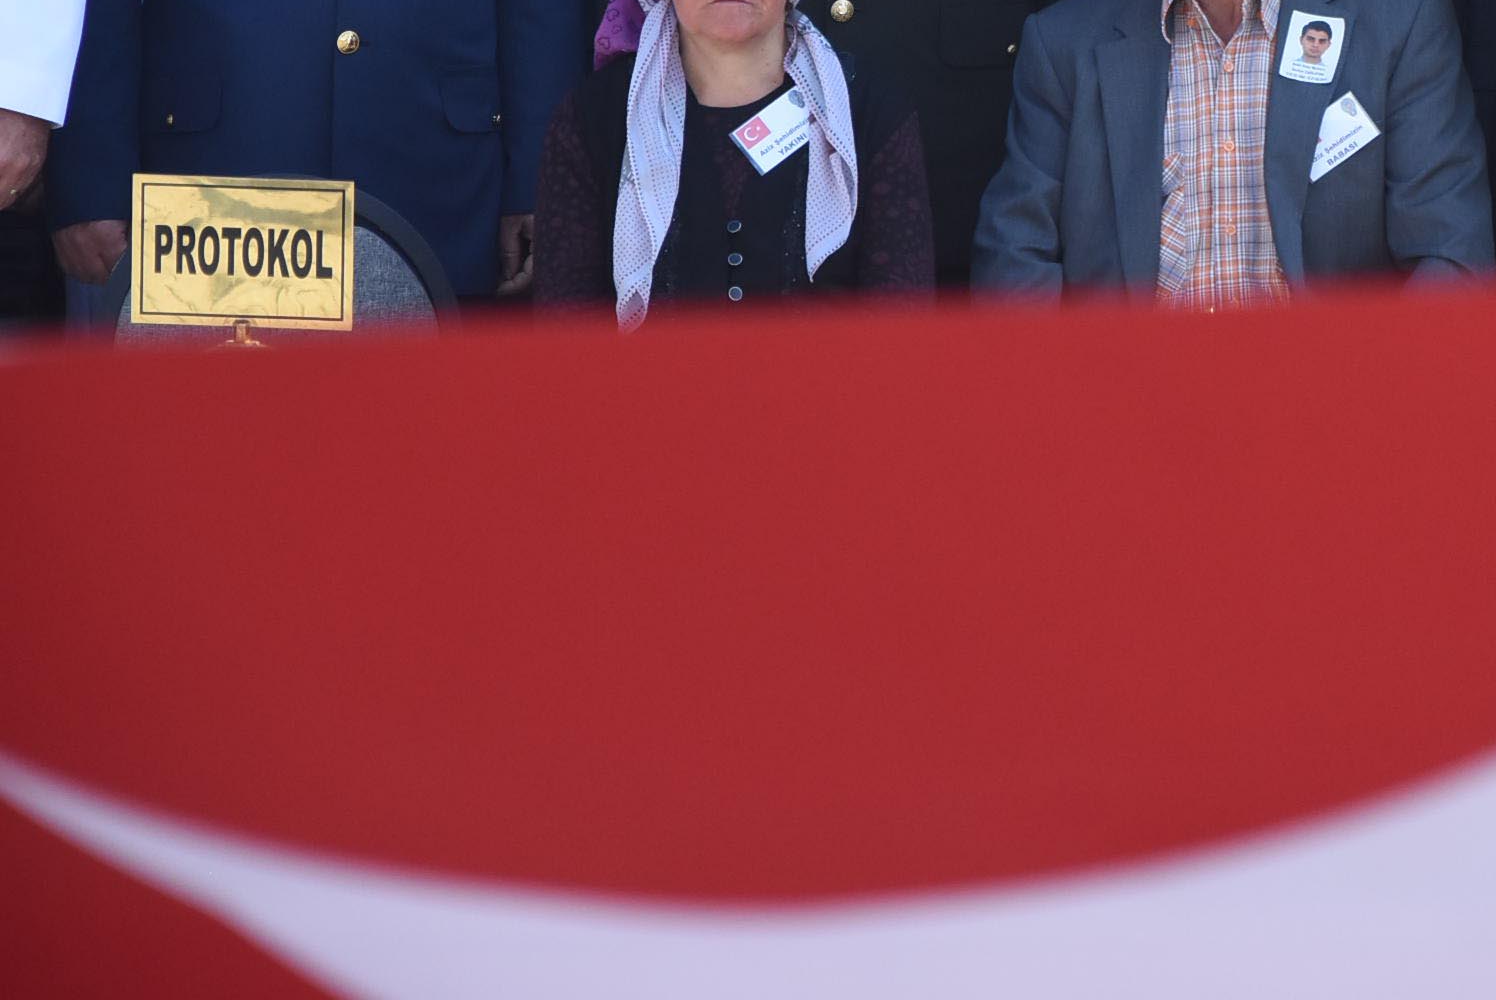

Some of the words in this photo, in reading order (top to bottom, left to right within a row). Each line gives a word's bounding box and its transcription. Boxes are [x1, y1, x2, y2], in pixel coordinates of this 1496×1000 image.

[774, 117, 809, 146] Şehidimizi
[778, 132, 808, 156] YAKINI
[1326, 140, 1359, 167] BABASI
[154, 224, 333, 280] PROTOKOL
